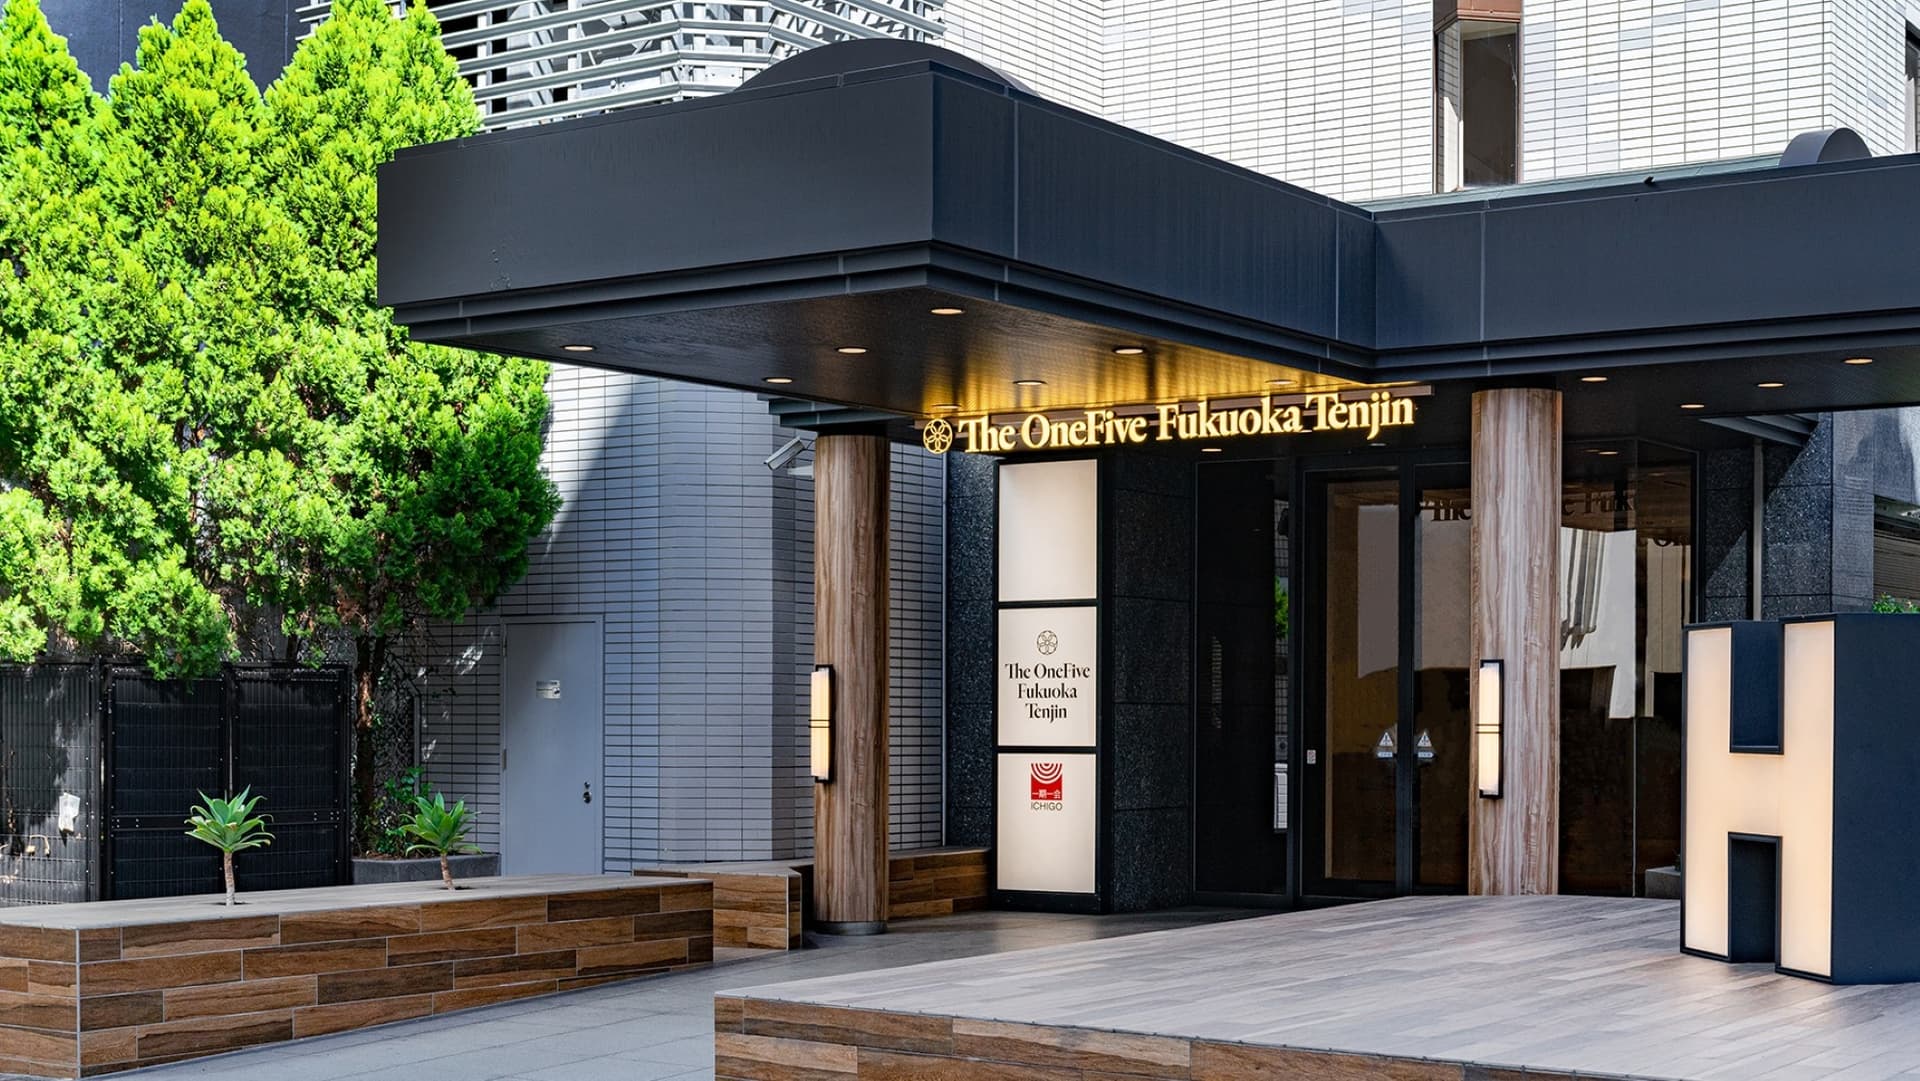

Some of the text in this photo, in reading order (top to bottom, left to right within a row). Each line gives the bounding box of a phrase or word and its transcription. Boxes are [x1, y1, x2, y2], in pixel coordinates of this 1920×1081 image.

[958, 391, 1416, 453] The OneFive Fukuoka Tenjin
[1005, 663, 1091, 679] The OneFive
[1017, 682, 1078, 699] Fukuoka
[1025, 703, 1068, 723] Tenjin
[1030, 801, 1063, 811] ICHIGO
